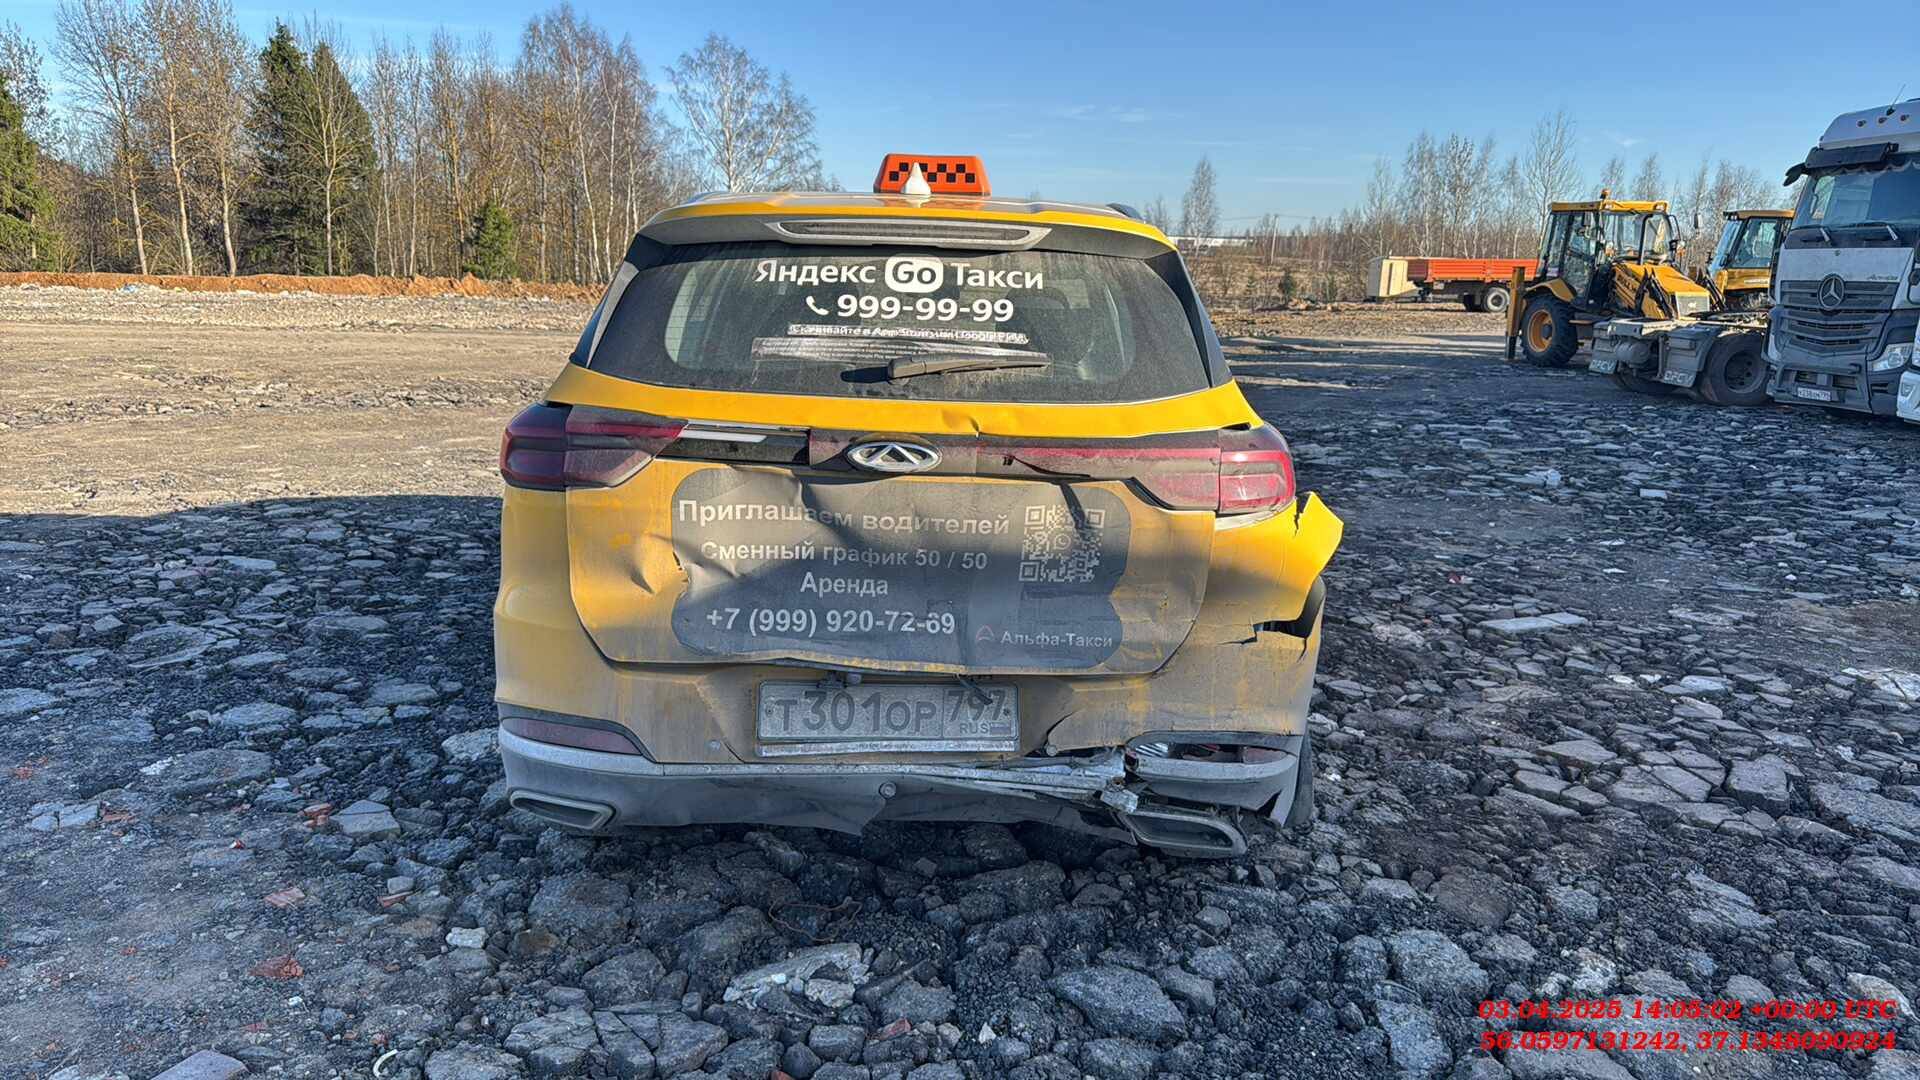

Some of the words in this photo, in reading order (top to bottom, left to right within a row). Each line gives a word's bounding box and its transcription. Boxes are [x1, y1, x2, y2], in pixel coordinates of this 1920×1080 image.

[755, 259, 876, 286] Яндекс
[892, 261, 937, 285] Go
[951, 262, 1044, 290] Такси
[837, 294, 1014, 322] 999-99-99
[679, 499, 853, 527] Приглашаем
[863, 514, 1010, 534] водителей
[701, 540, 815, 561] Сменный
[823, 545, 907, 567] график
[915, 549, 941, 567] 50
[947, 551, 955, 568] /
[961, 552, 988, 570] 50
[800, 571, 889, 597] Аренда
[706, 607, 741, 630] +7
[750, 608, 818, 638] (999)
[826, 610, 956, 635] 920-72-69
[1000, 630, 1113, 649] Альфа-Такси
[960, 722, 989, 734] RUS
